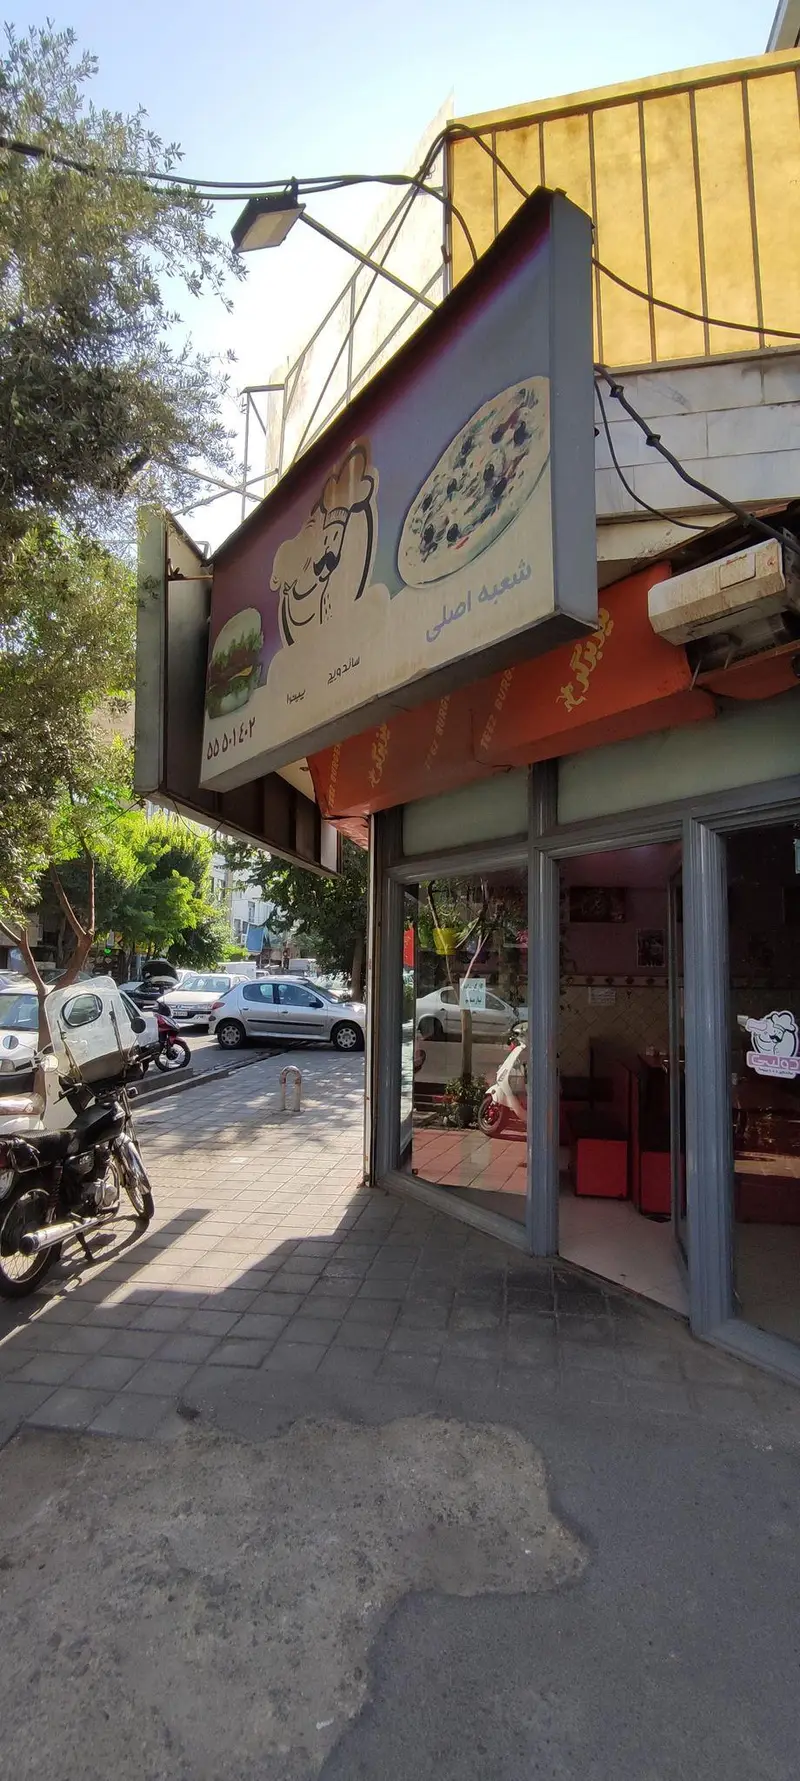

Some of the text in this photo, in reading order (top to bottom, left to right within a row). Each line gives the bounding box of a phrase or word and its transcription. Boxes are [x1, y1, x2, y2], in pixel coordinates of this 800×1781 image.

[425, 558, 534, 643] شعبه اصلی
[327, 655, 361, 685] ساندویچ
